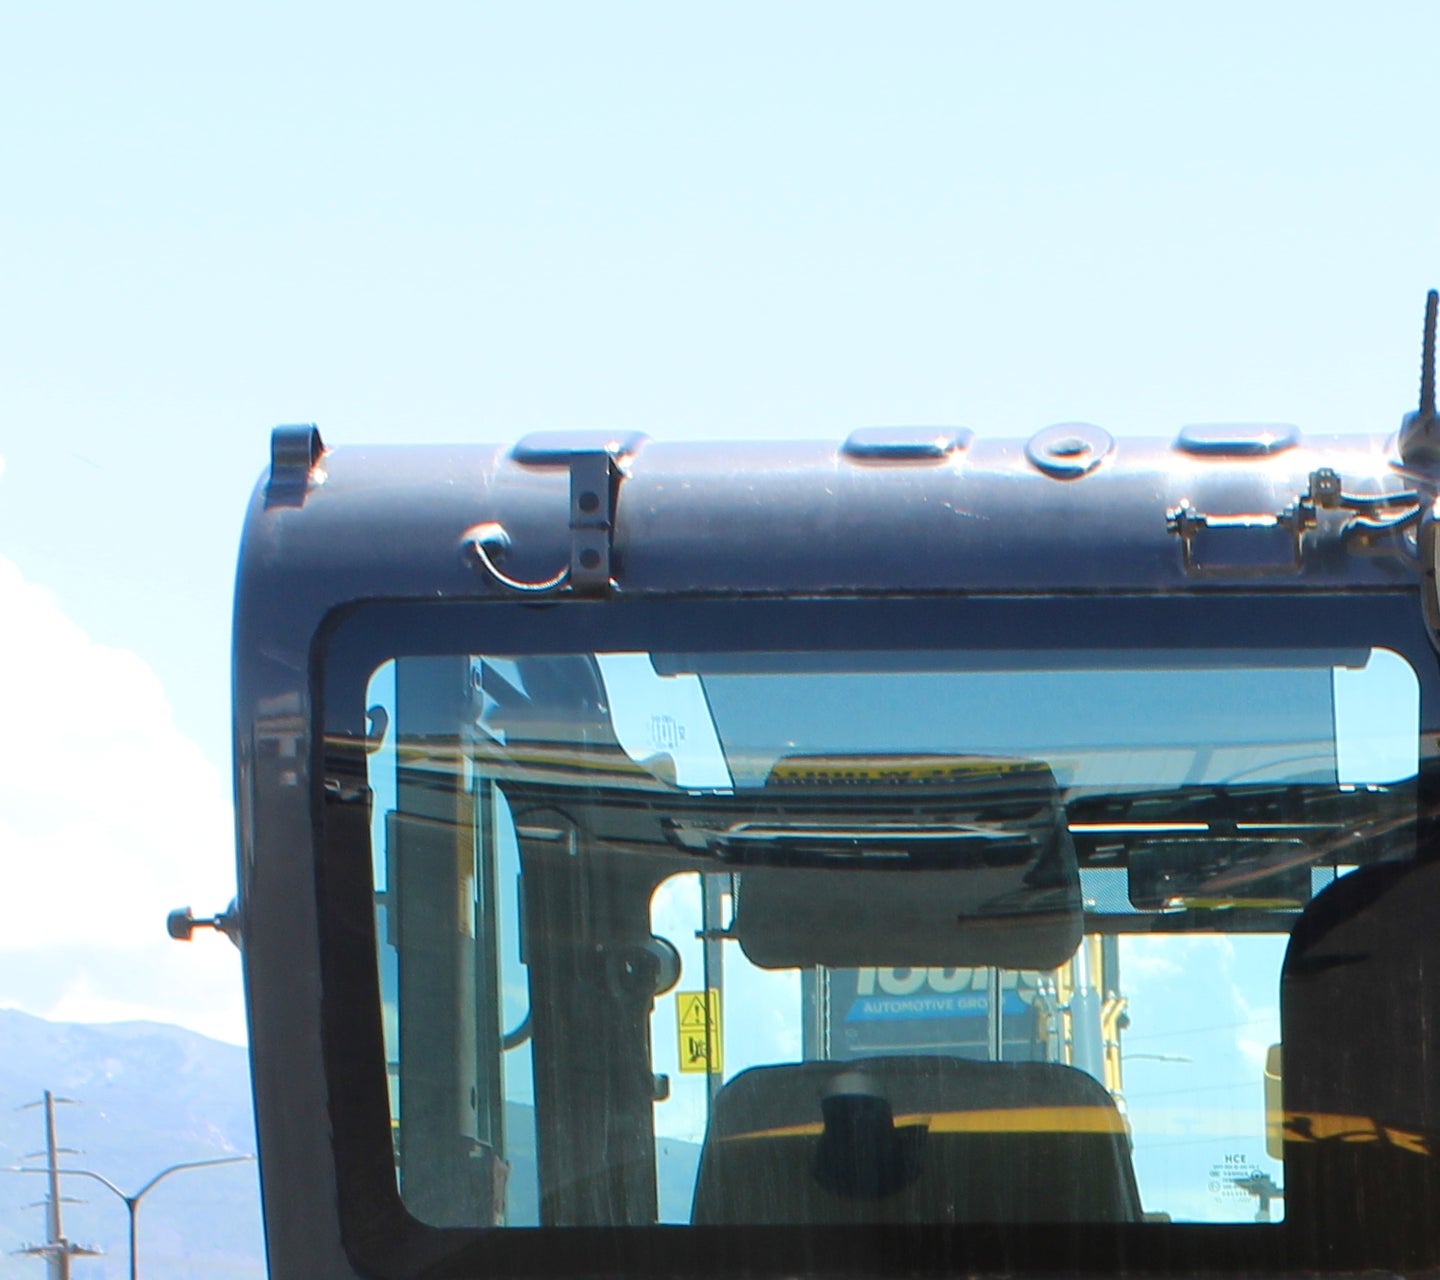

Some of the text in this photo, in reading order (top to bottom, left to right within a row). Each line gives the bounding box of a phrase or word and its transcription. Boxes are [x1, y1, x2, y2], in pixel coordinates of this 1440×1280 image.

[864, 997, 1006, 1013] AUTOMOTIVE GRO
[1224, 1154, 1247, 1164] HCE
